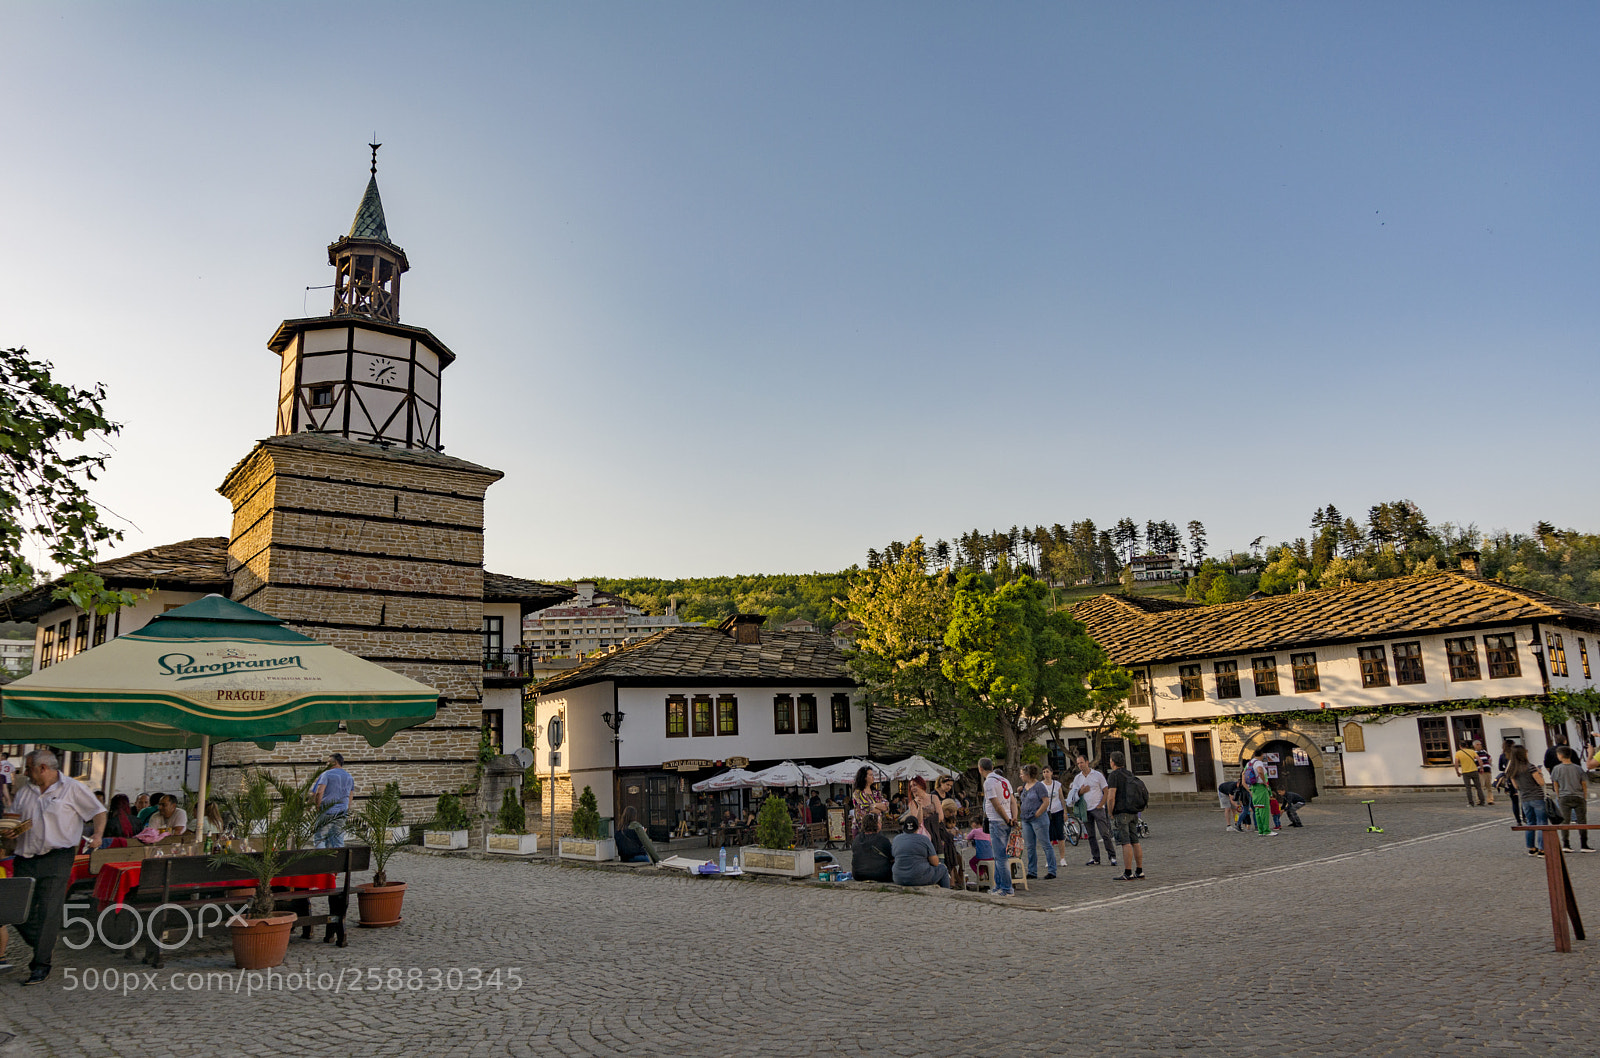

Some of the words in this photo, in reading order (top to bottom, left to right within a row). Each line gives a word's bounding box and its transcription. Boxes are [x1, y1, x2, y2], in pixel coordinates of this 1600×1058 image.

[158, 653, 308, 681] Staropramen
[216, 690, 266, 700] PRAGUE
[1001, 780, 1011, 800] 8
